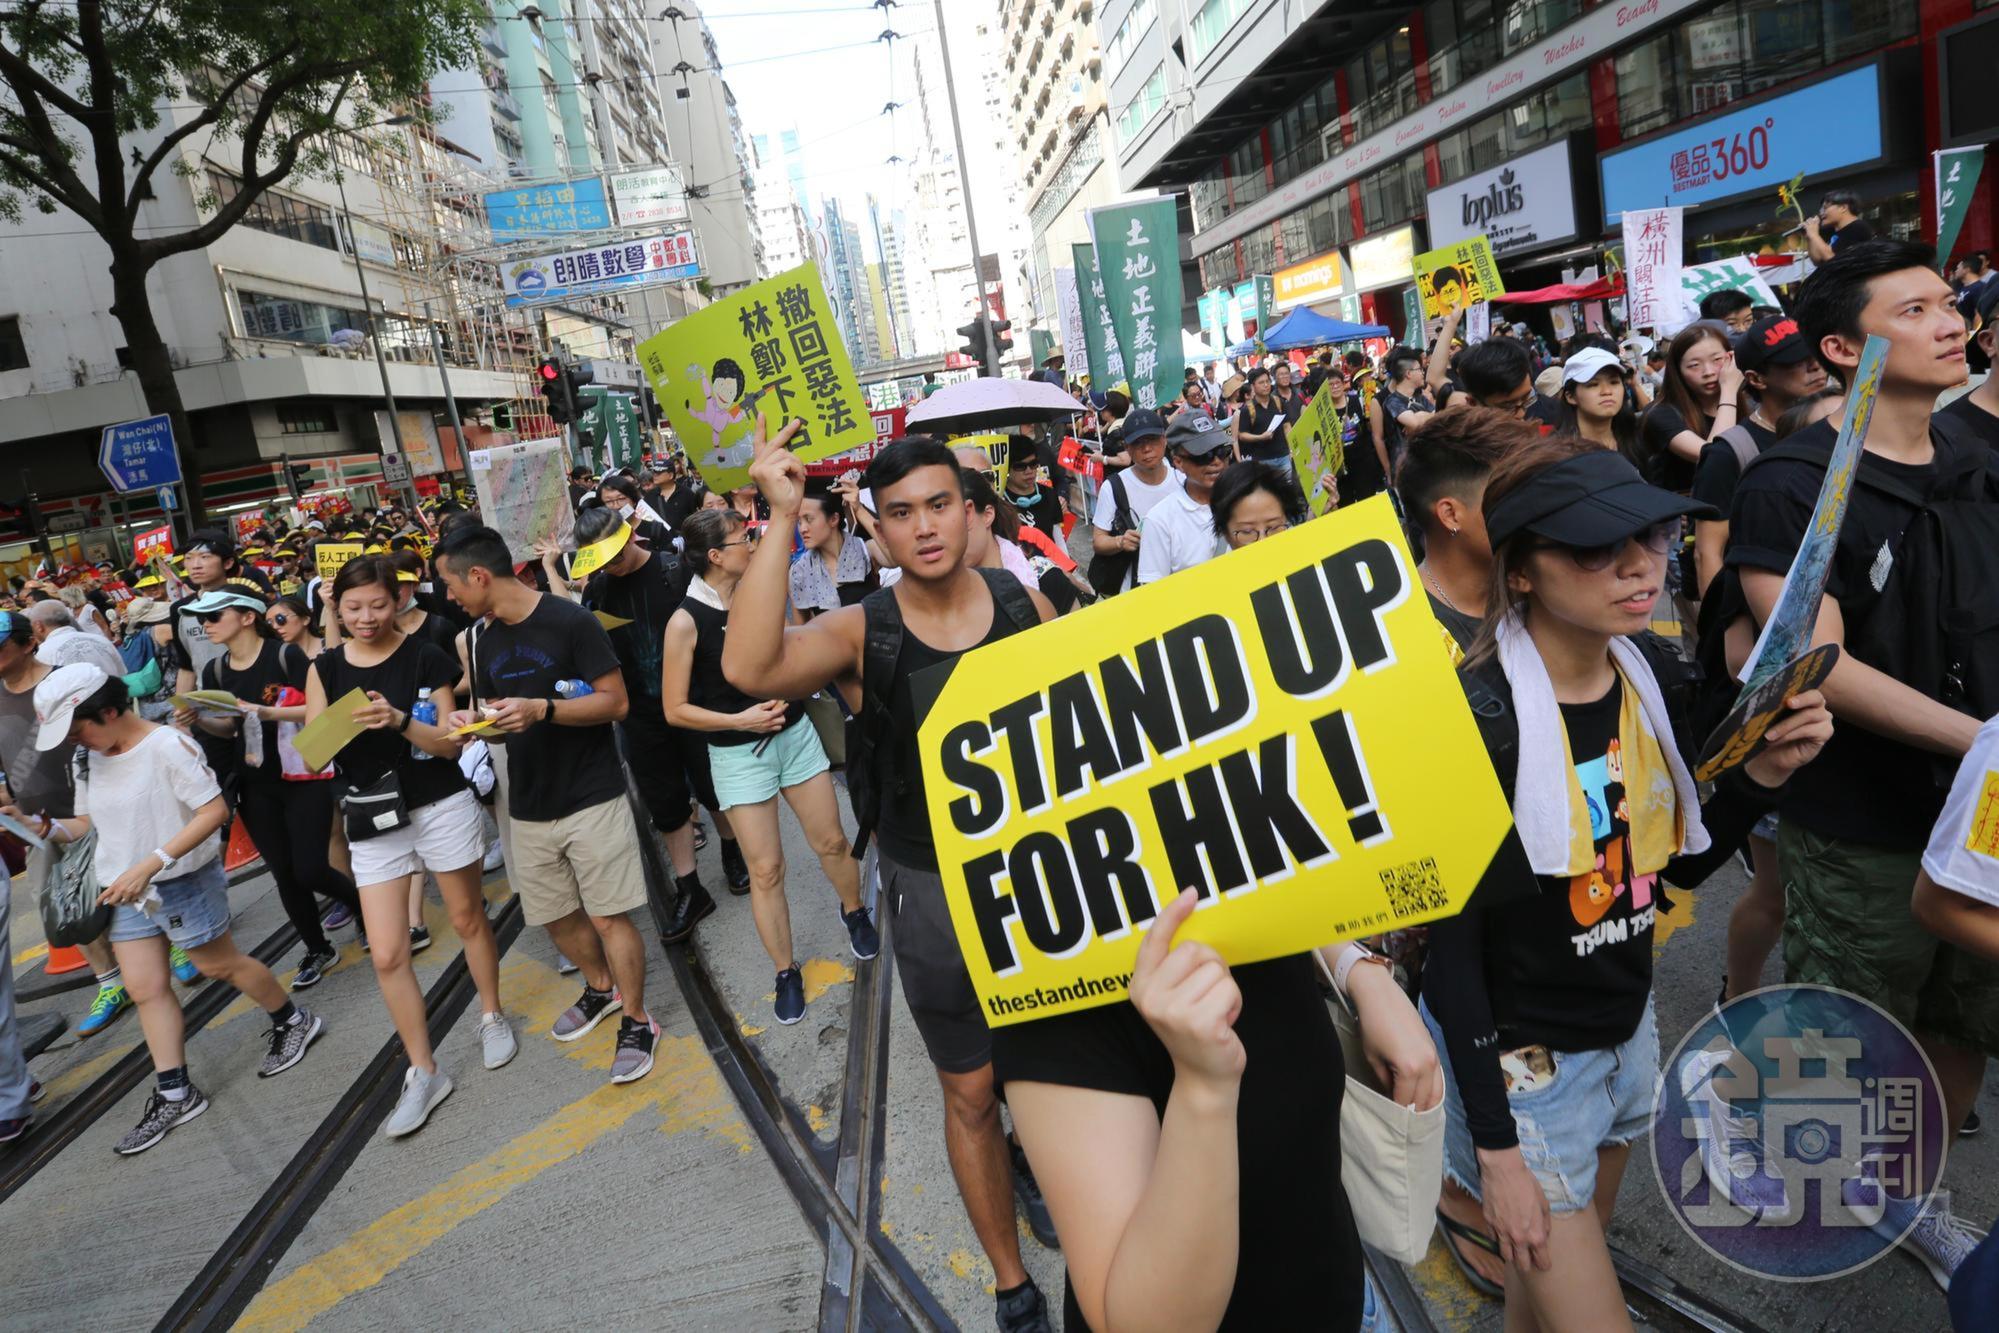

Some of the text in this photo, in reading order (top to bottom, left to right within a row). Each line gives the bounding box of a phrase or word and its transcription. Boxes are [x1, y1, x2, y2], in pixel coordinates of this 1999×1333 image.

[1616, 0, 1660, 27] Beauty
[1544, 34, 1586, 66] Watches
[1487, 68, 1525, 97] Jewellery
[1438, 100, 1467, 123] Fashion
[1395, 122, 1425, 146] Cosmetics
[1673, 174, 1711, 193] BESTMART
[552, 244, 647, 285] 朗晴數學
[1122, 218, 1158, 410] 土地正義聯盟
[775, 283, 857, 438] 撤回惡法
[738, 299, 812, 453] 林鄭下台
[118, 430, 135, 440] Wan
[123, 457, 146, 467] Tamar
[989, 442, 1008, 467] UP
[940, 537, 1412, 841] STAND UP
[961, 804, 1161, 977] FOR
[1571, 917, 1628, 957] TSUM
